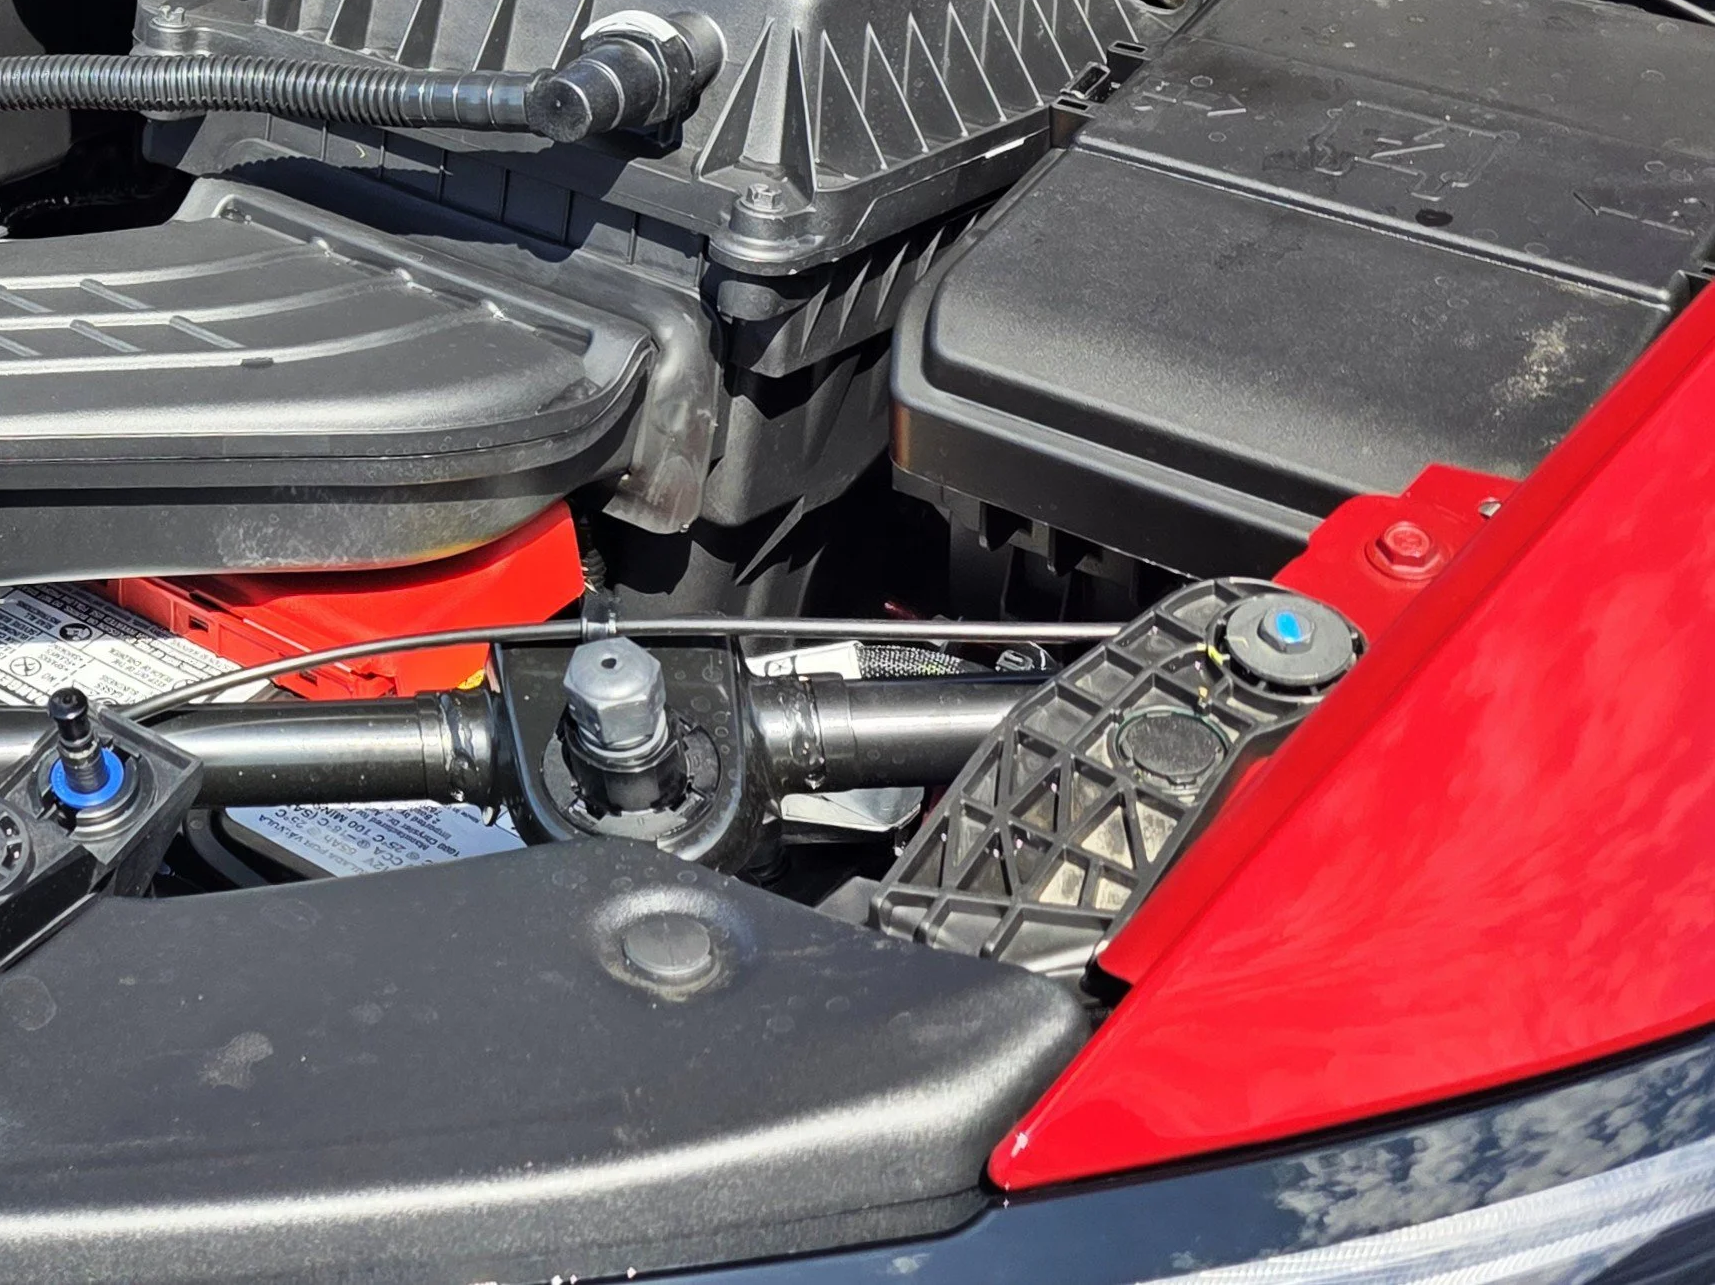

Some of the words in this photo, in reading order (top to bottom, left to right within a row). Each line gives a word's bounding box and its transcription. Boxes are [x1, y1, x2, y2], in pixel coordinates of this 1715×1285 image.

[37, 671, 58, 683] NO
[345, 819, 373, 836] 100
[398, 821, 441, 846] Chrysler
[408, 814, 454, 841] Imported
[324, 851, 365, 875] ULADA
[360, 854, 391, 873] 12V
[369, 845, 406, 867] CCA
